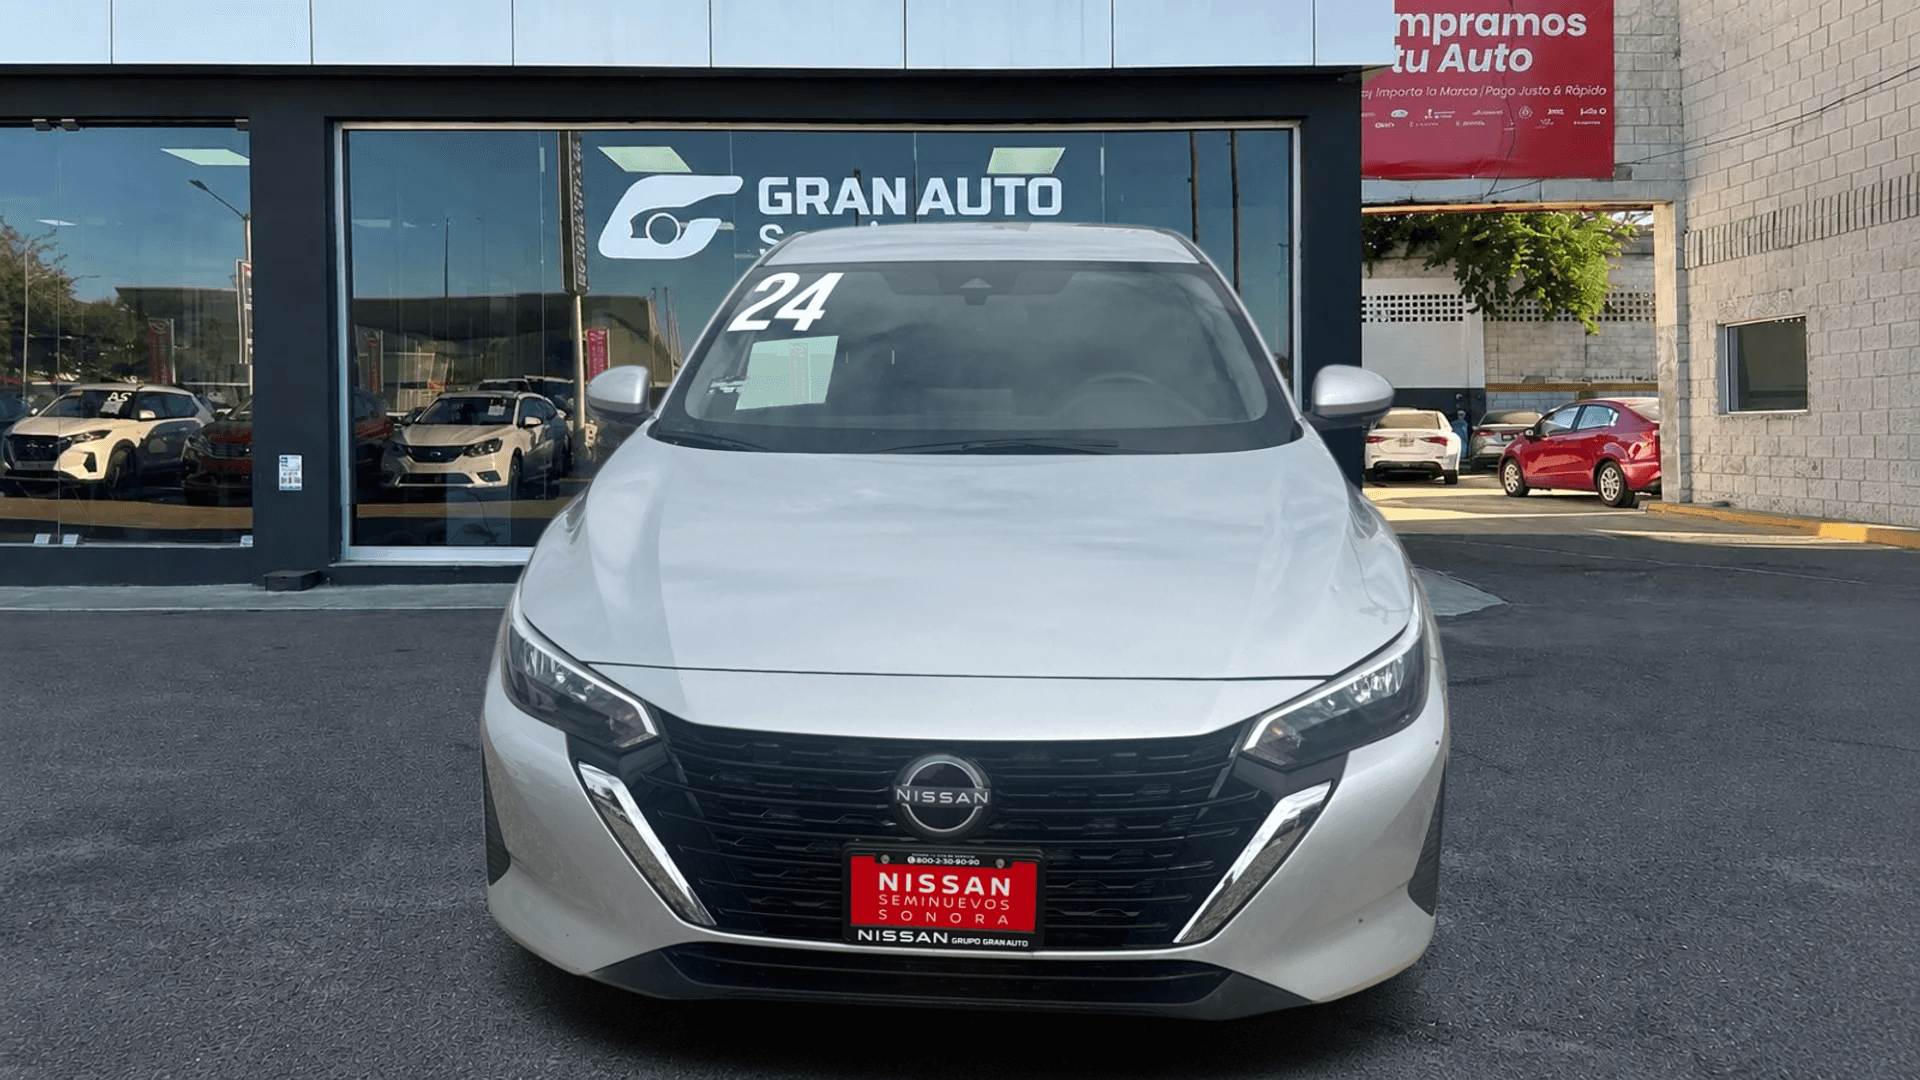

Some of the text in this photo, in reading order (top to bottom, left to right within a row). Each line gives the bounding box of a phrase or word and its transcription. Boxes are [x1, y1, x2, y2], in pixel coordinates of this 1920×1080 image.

[1395, 13, 1587, 45] mpramos
[1393, 43, 1533, 73] tu Auto
[1376, 87, 1423, 100] Importa
[1426, 86, 1437, 97] la
[1519, 86, 1551, 96] Justo
[1553, 85, 1561, 96] &
[759, 177, 1063, 216] GRAN AUTO
[727, 272, 845, 332] 24
[896, 788, 989, 804] NISSAN
[879, 872, 1010, 897] NISSAN
[879, 893, 1010, 911] SEMINUEVOS
[879, 908, 1009, 925] SONORA
[858, 929, 948, 944] NISSAN
[951, 937, 981, 945] GRUPO
